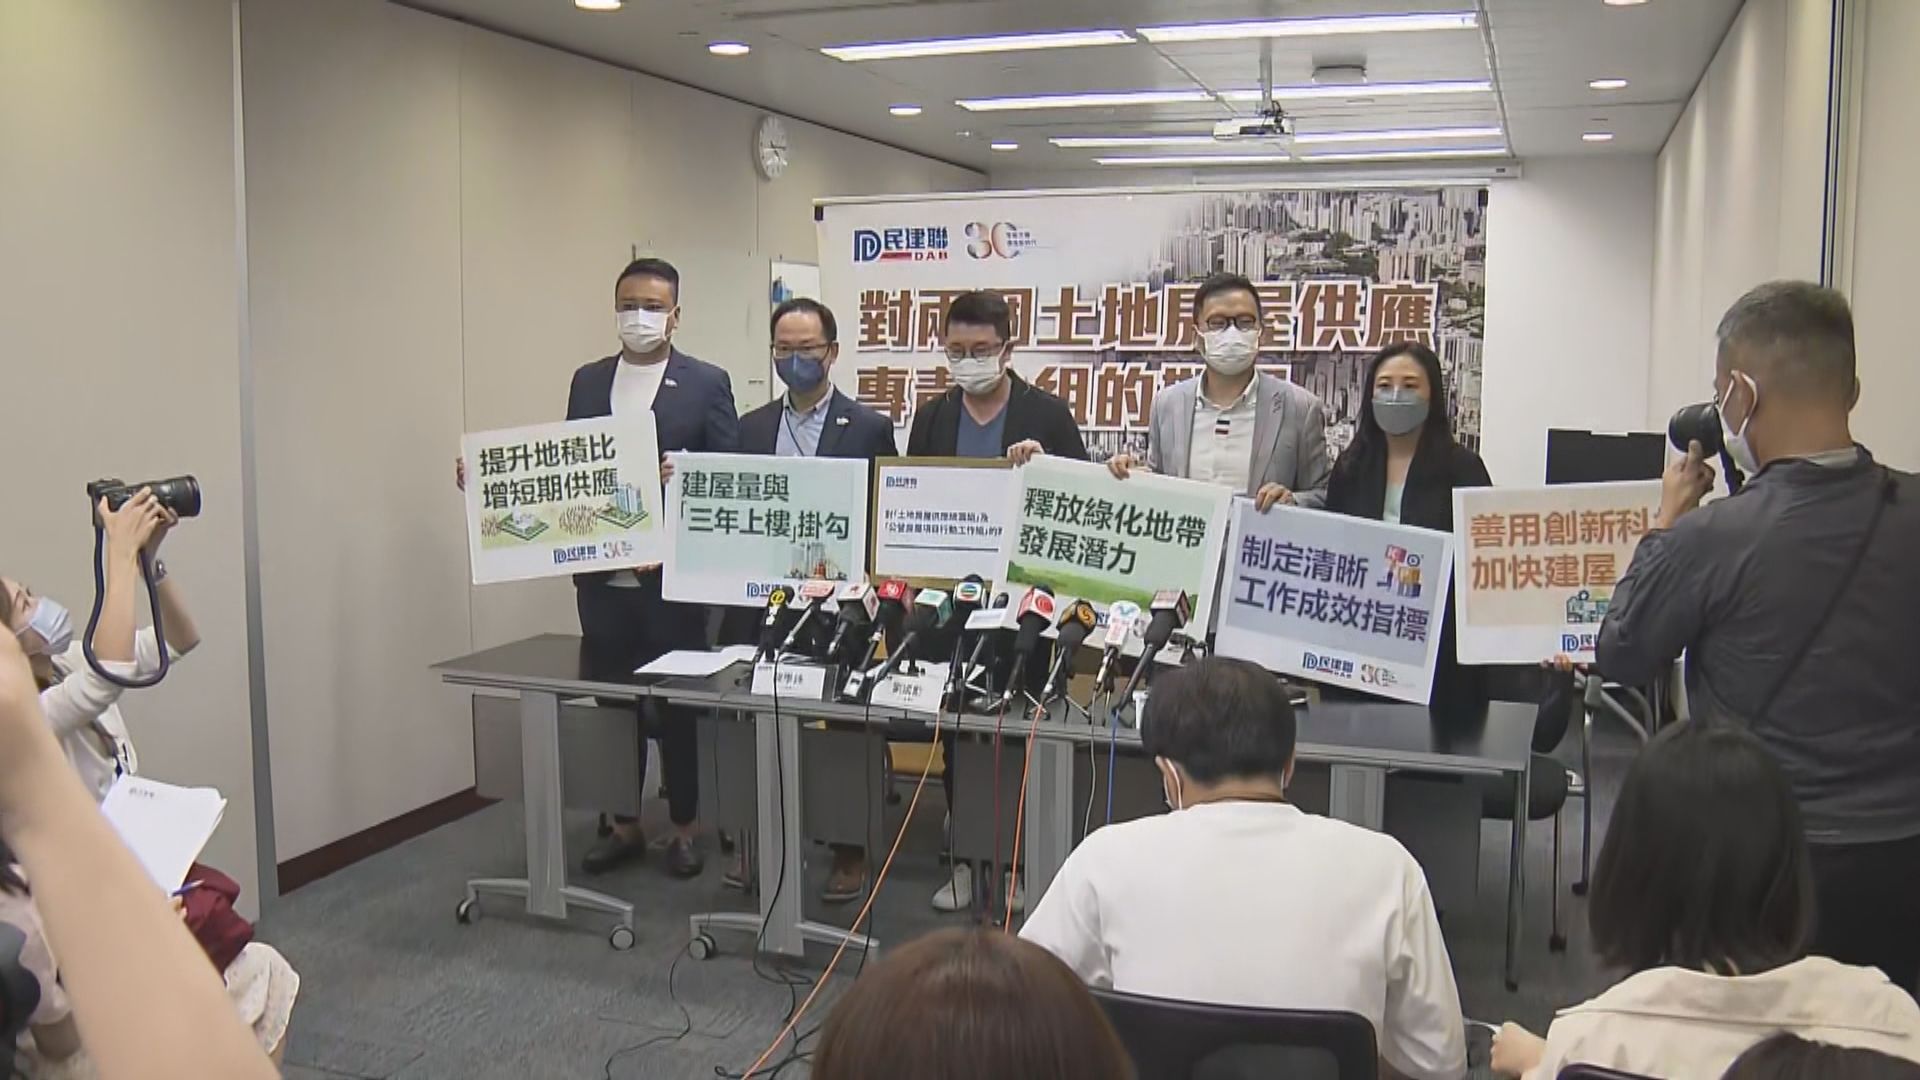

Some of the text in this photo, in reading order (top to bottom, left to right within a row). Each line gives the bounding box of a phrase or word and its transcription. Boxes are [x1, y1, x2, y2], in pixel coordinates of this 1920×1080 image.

[884, 226, 949, 250] 民建聯
[914, 251, 949, 262] DAB
[480, 432, 616, 477] 提升地積比
[483, 468, 619, 509] 增短期供應
[681, 471, 790, 502] 建屋量與
[680, 501, 850, 543] 「三年上樓」掛勾
[1023, 487, 1206, 549] 釋放綠化地帶
[1470, 507, 1661, 549] 善用創新科
[1018, 524, 1136, 575] 發展潛力
[1241, 535, 1369, 589] 制定清晰
[1471, 553, 1617, 590] 加快建屋
[1235, 576, 1430, 643] 工作成效指標
